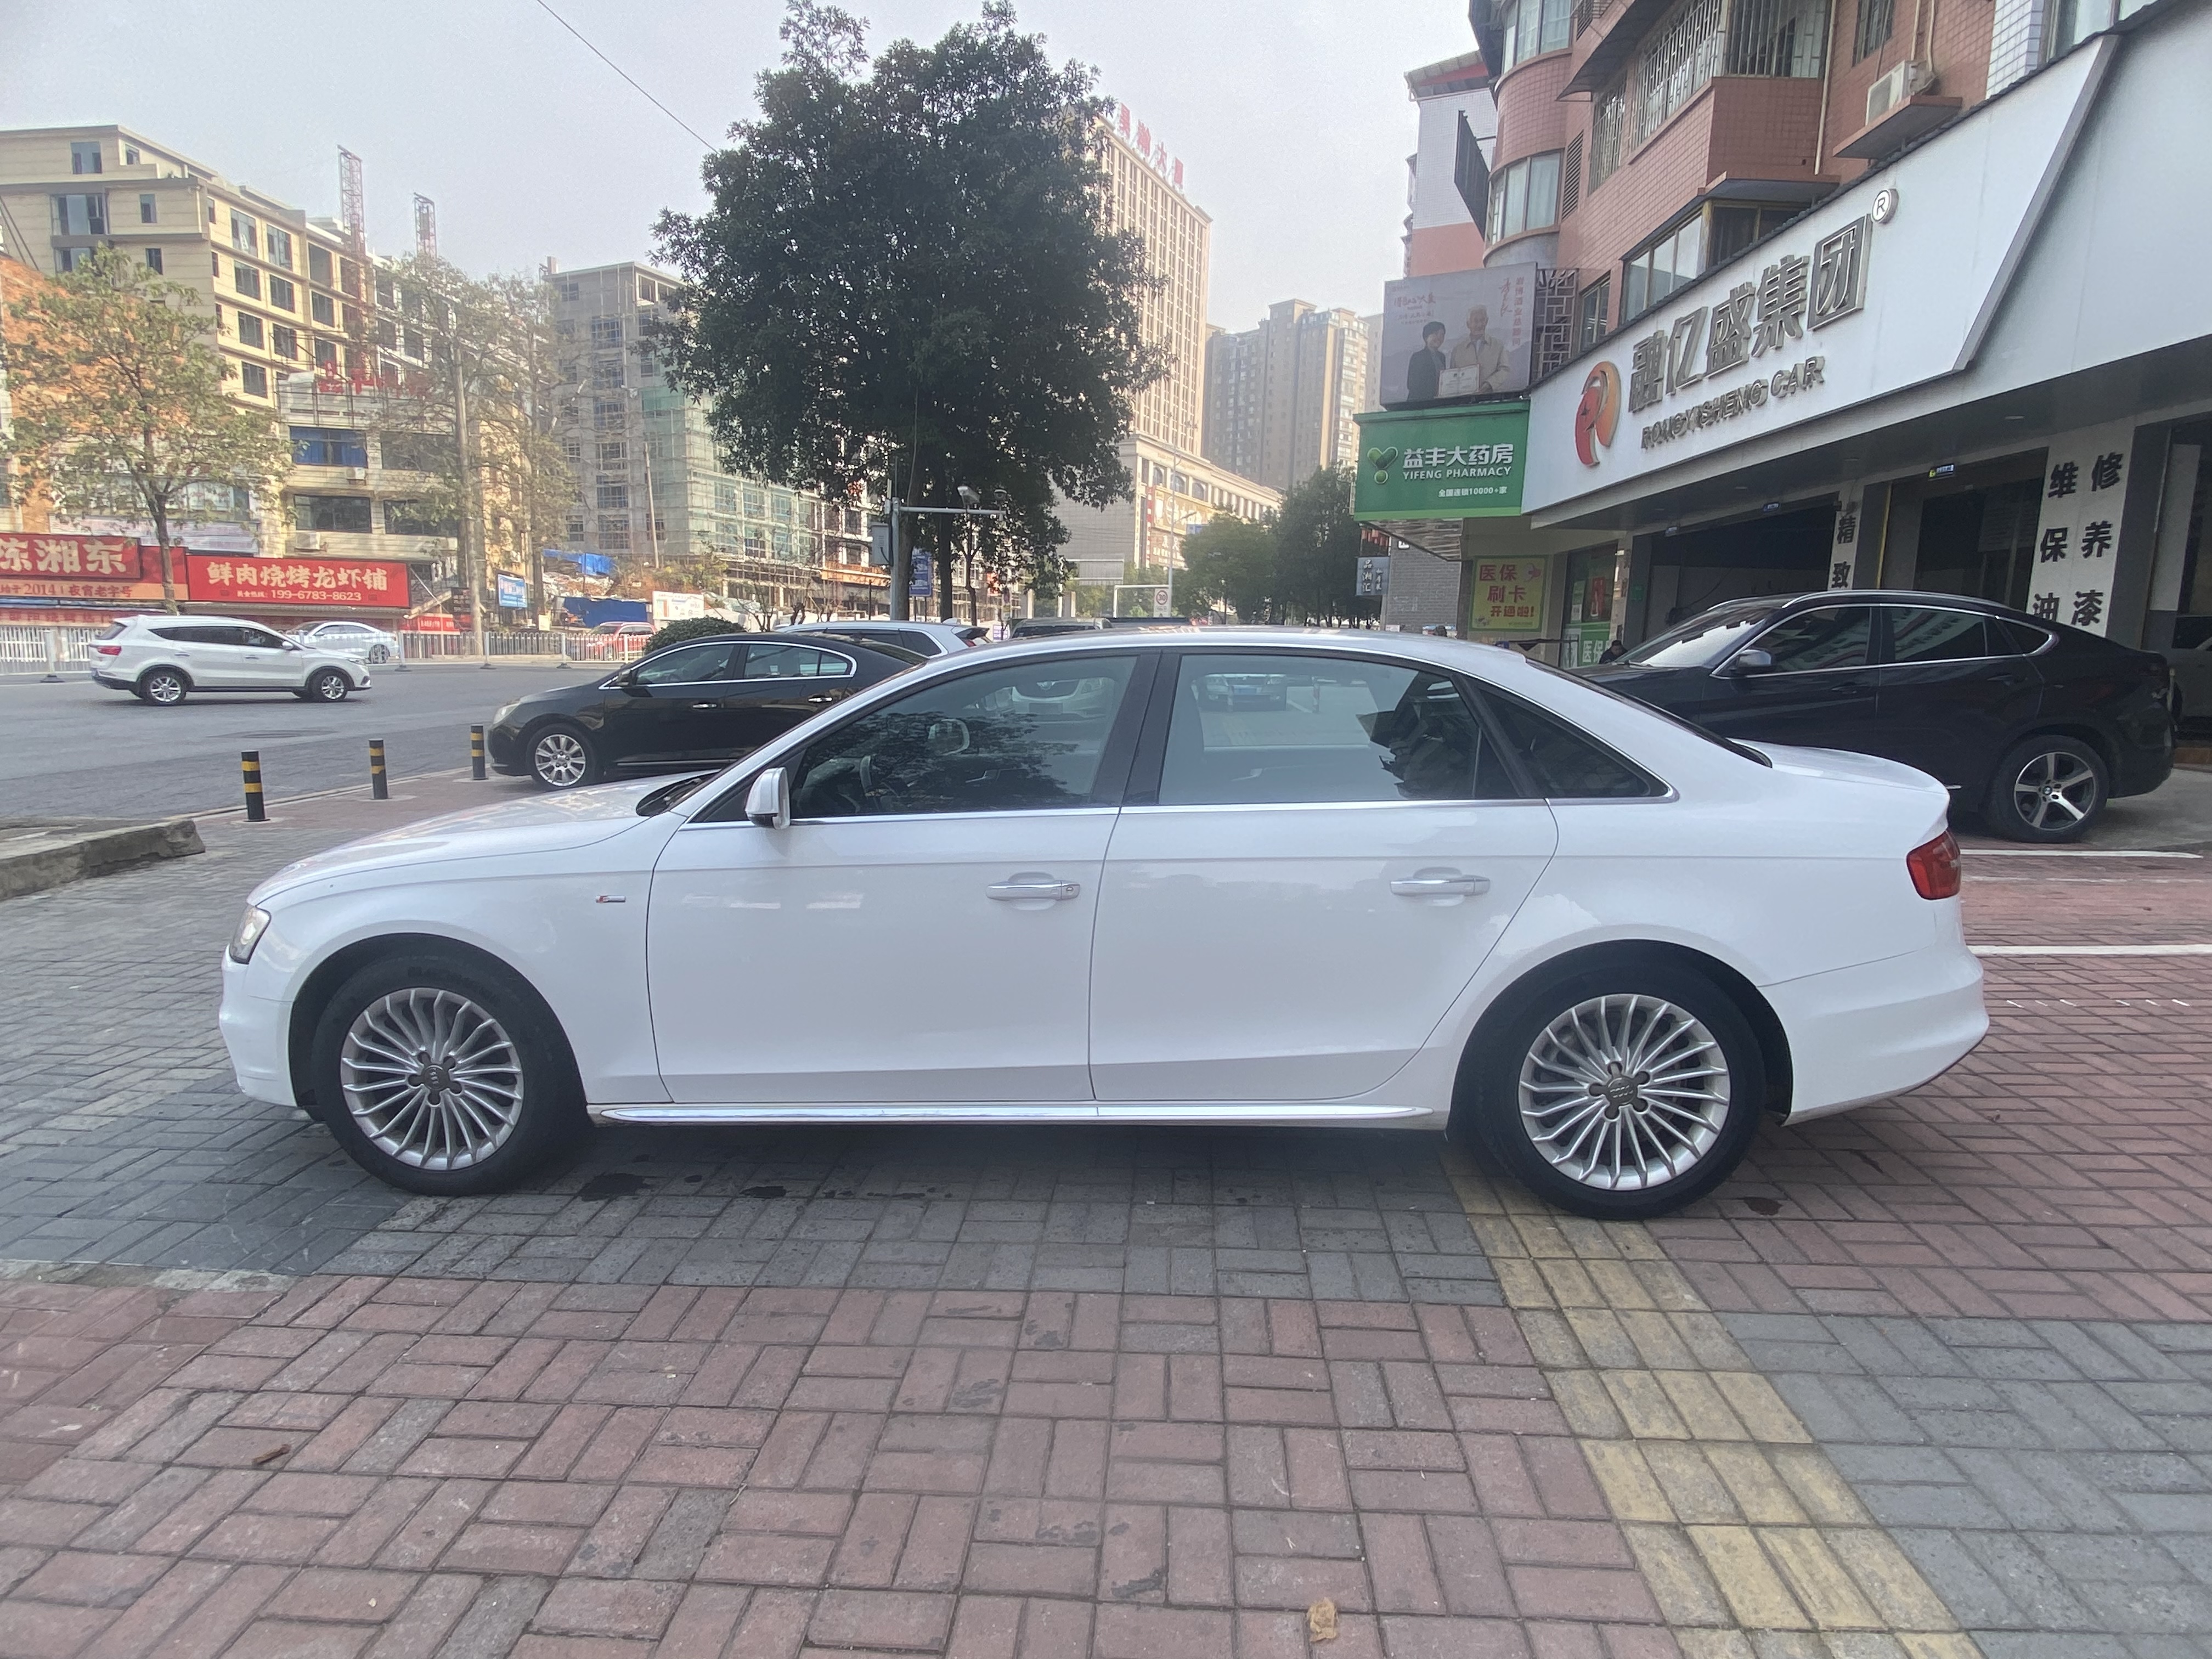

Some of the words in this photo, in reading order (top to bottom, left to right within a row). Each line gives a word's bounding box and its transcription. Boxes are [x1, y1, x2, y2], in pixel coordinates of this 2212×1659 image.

[1628, 213, 1871, 413] 融亿盛集团
[1771, 356, 1825, 398] CAR
[1403, 443, 1514, 469] 益丰大药房
[1403, 470, 1442, 479] YIFENG
[1446, 466, 1511, 477] PHARMACY
[2047, 452, 2124, 498] 维修
[1831, 515, 1857, 589] 精致
[2040, 520, 2113, 562] 保养
[206, 561, 388, 591] 鲜肉烧烤龙虾铺
[1479, 564, 1517, 582] 医保
[271, 590, 362, 601] 199-6783-8623
[1487, 585, 1527, 603] 刷卡
[2032, 589, 2104, 626] 油漆
[1582, 640, 1610, 663] 医保
